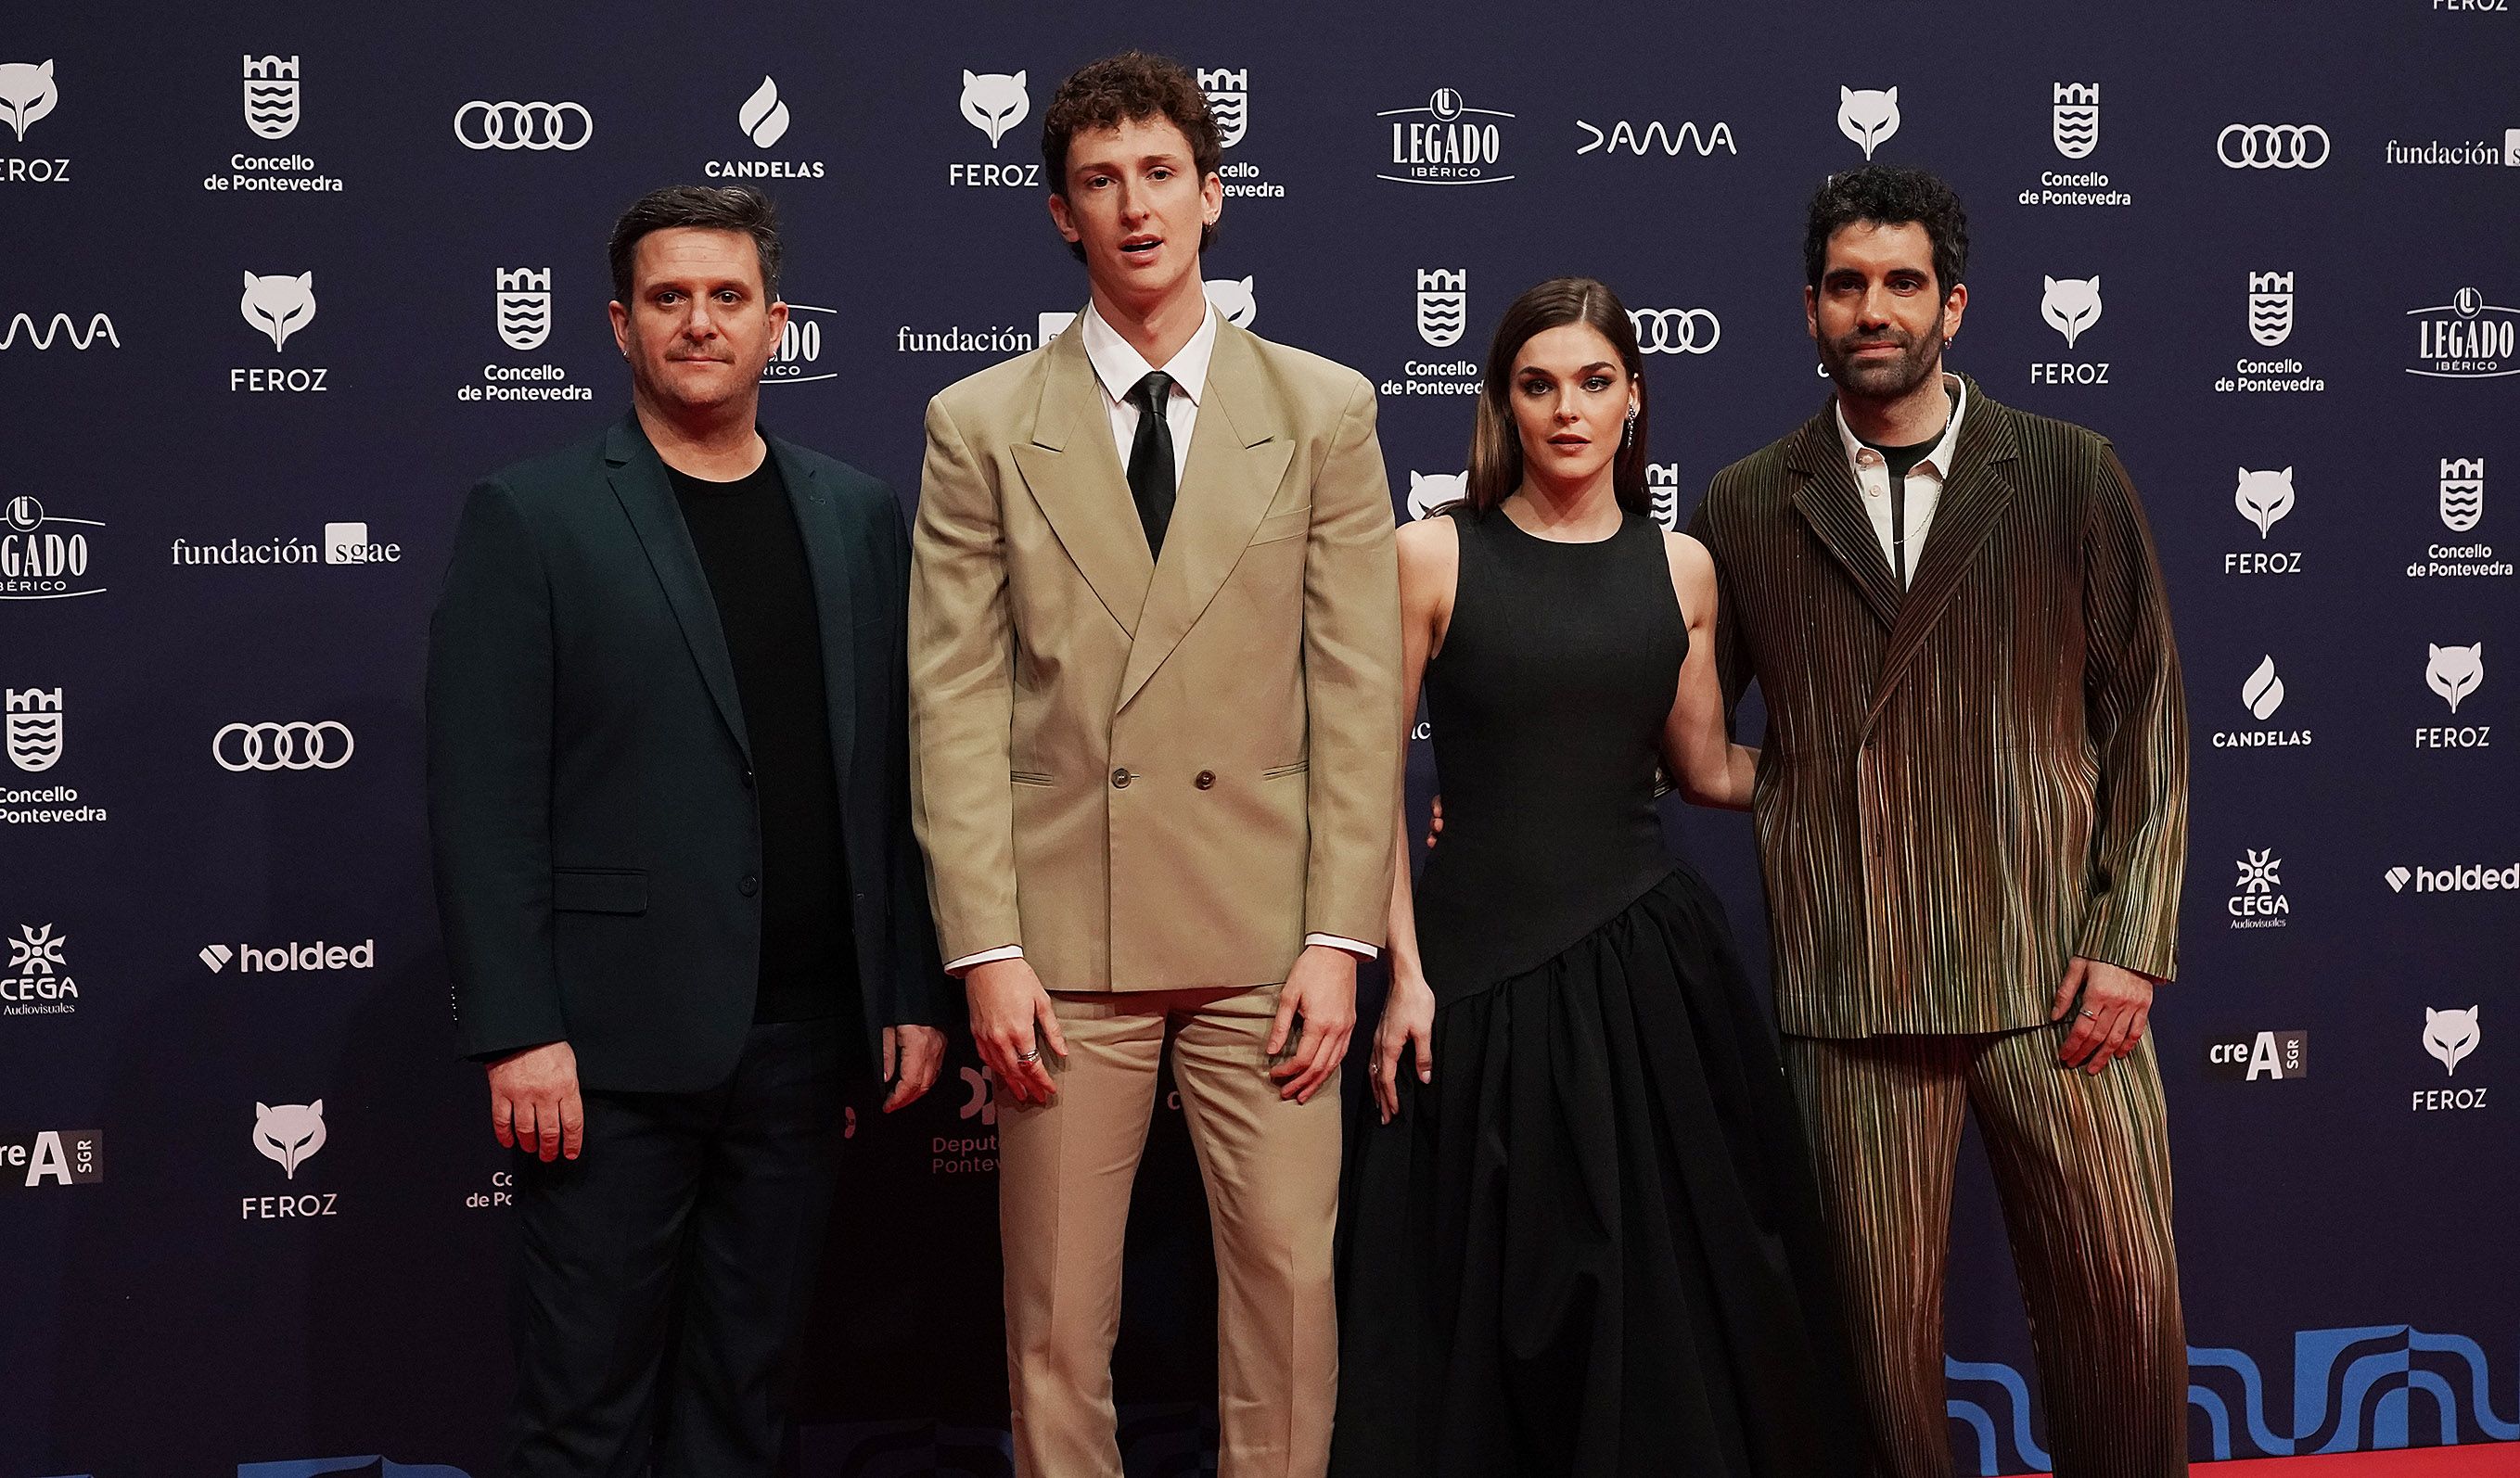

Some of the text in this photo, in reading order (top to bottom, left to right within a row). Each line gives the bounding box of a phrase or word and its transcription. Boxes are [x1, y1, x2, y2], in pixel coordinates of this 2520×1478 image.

[1394, 123, 1499, 163] LEGADO
[2386, 140, 2498, 164] fundación
[0, 159, 70, 182] ROZ
[232, 154, 314, 170] Concello
[705, 161, 824, 178] CANDELAS
[1220, 162, 1259, 177] cello
[951, 164, 1039, 186] FEROZ
[1412, 166, 1480, 177] IBÉRICO
[2041, 172, 2108, 186] Concello
[204, 174, 342, 191] de Pontevedra
[1222, 182, 1285, 197] evedra
[2019, 190, 2130, 205] de Pontevedra
[897, 326, 1032, 351] fundación
[2421, 321, 2514, 358] LEGADO
[484, 364, 564, 380] Concello
[1405, 361, 1477, 376] Concello
[2031, 363, 2109, 384] FEROZ
[2237, 359, 2302, 373] Concello
[2437, 360, 2497, 371] IBÉRICO
[232, 369, 327, 391] FEROZ
[1381, 380, 1484, 394] de Ponteved
[2215, 376, 2323, 391] de Pontevedra
[458, 385, 592, 401] de Pontevedra
[2, 534, 87, 577] GADO
[172, 538, 401, 564] fundación sgae
[2429, 544, 2491, 558] Concello
[2226, 553, 2301, 573] FEROZ
[2407, 561, 2513, 577] de Pontevedra
[0, 580, 66, 591] ÉRICO
[2213, 731, 2311, 747] CANDELAS
[2416, 727, 2489, 747] FEROZ
[2417, 863, 2519, 892] holded
[2229, 895, 2289, 915] CEGA
[2231, 917, 2285, 928] Audiovisuales
[241, 939, 373, 972] holded
[0, 977, 78, 1000] CEGA
[4, 1002, 74, 1014] Audiovisuales
[2210, 1032, 2283, 1080] creA
[2287, 1039, 2298, 1068] SGR
[2413, 1089, 2487, 1111] FEROZ
[0, 1131, 72, 1186] reA
[78, 1140, 92, 1172] SGR
[243, 1194, 337, 1219] FEROZ
[467, 1193, 489, 1207] de
